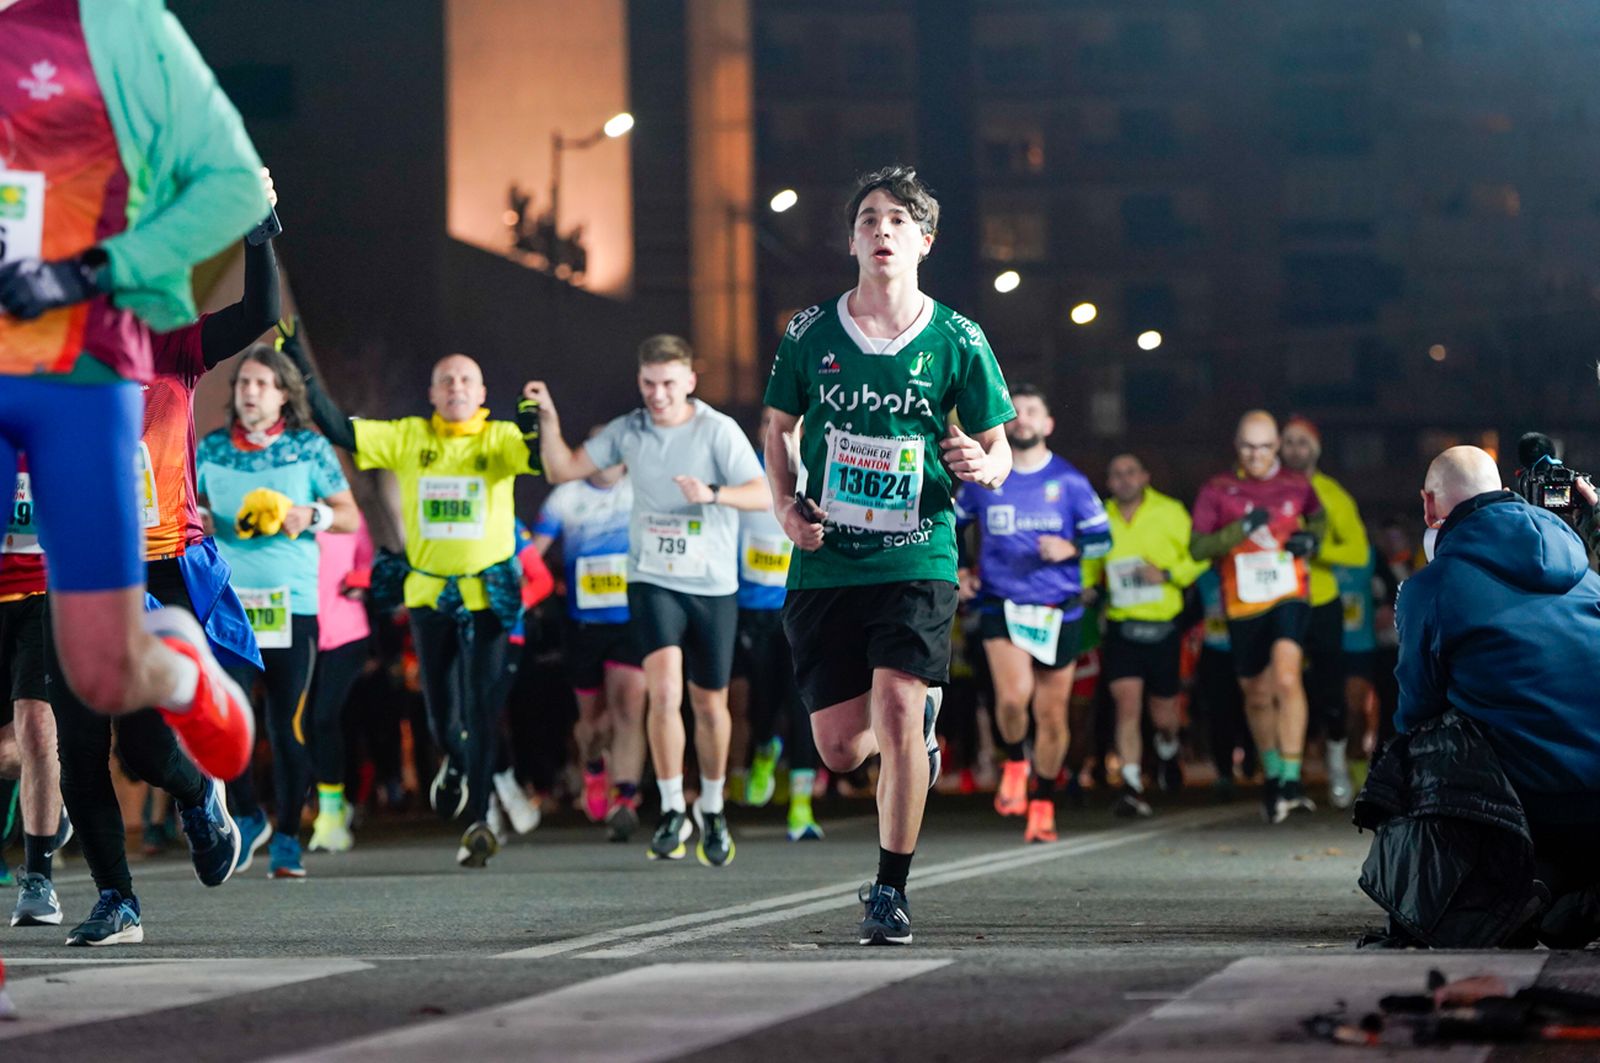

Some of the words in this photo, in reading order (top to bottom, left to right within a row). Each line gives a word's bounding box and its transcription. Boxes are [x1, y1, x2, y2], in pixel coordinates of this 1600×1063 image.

[951, 310, 984, 347] vitaly
[819, 383, 934, 417] Kubota
[838, 452, 856, 465] SAN
[857, 458, 891, 471] ANTON
[850, 444, 879, 458] NOCHE
[880, 449, 892, 460] DE
[838, 465, 912, 500] 13624
[657, 536, 687, 555] 739
